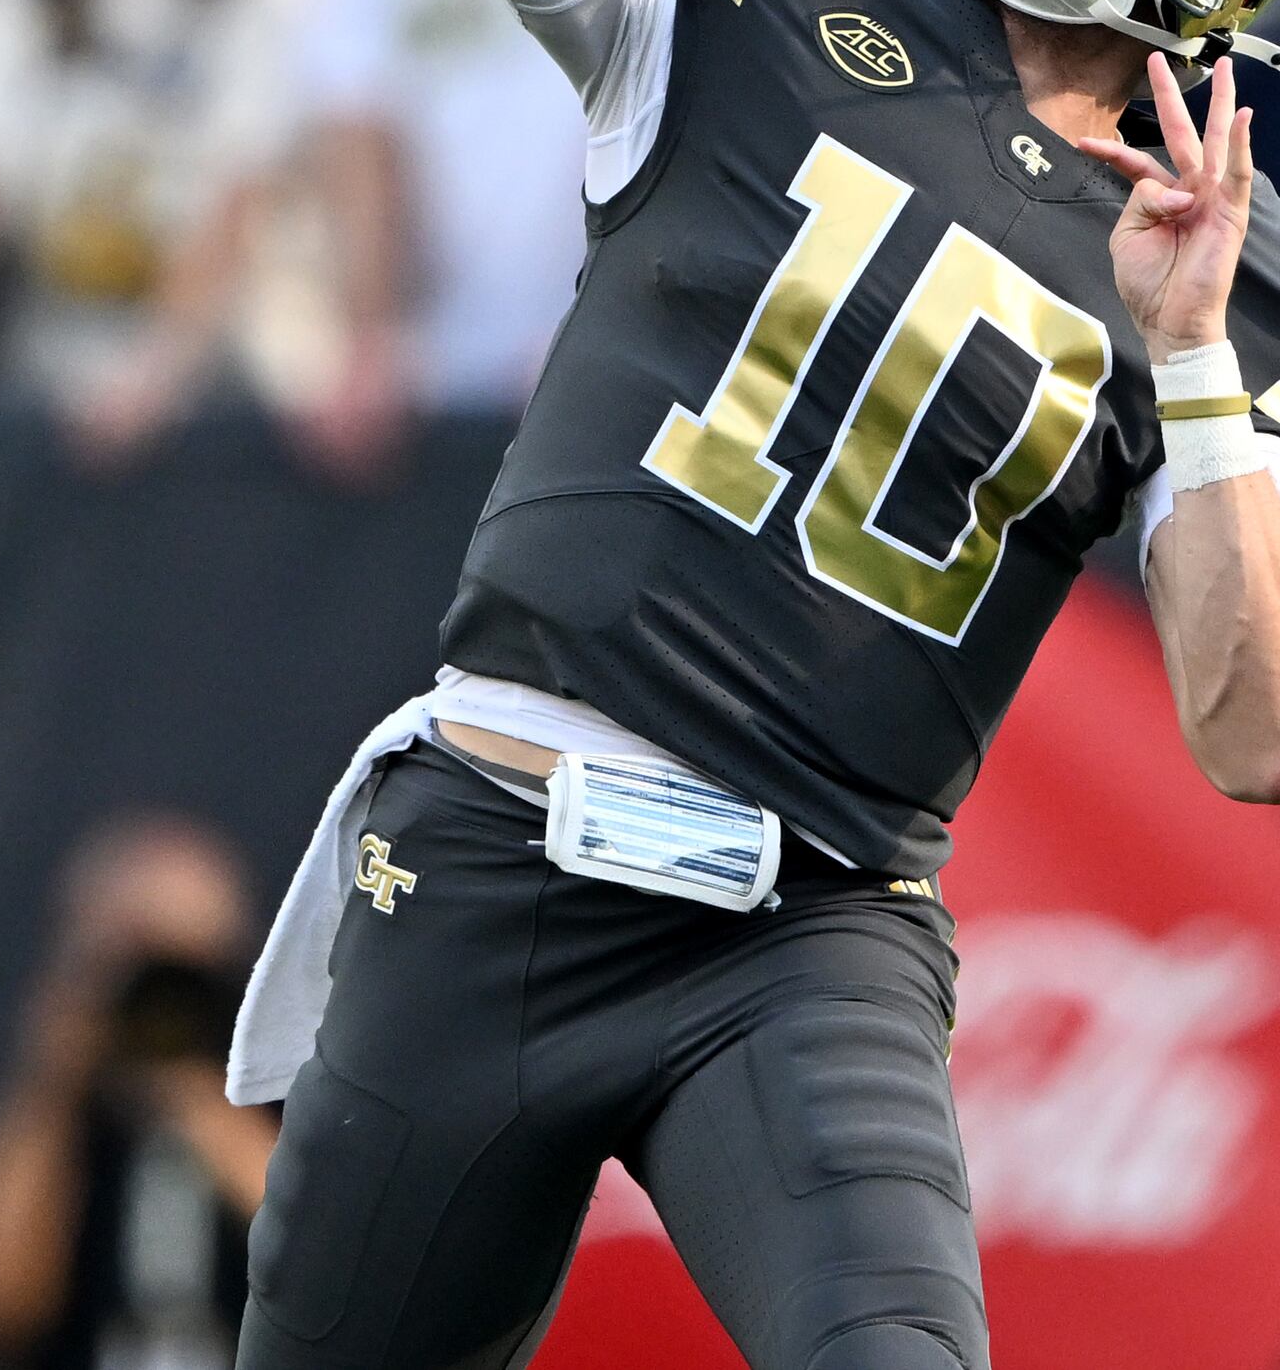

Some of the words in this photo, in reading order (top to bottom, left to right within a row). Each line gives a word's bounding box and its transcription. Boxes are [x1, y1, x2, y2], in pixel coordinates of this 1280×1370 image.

[830, 29, 904, 74] ACC
[640, 132, 1112, 647] 10
[354, 833, 418, 915] GT
